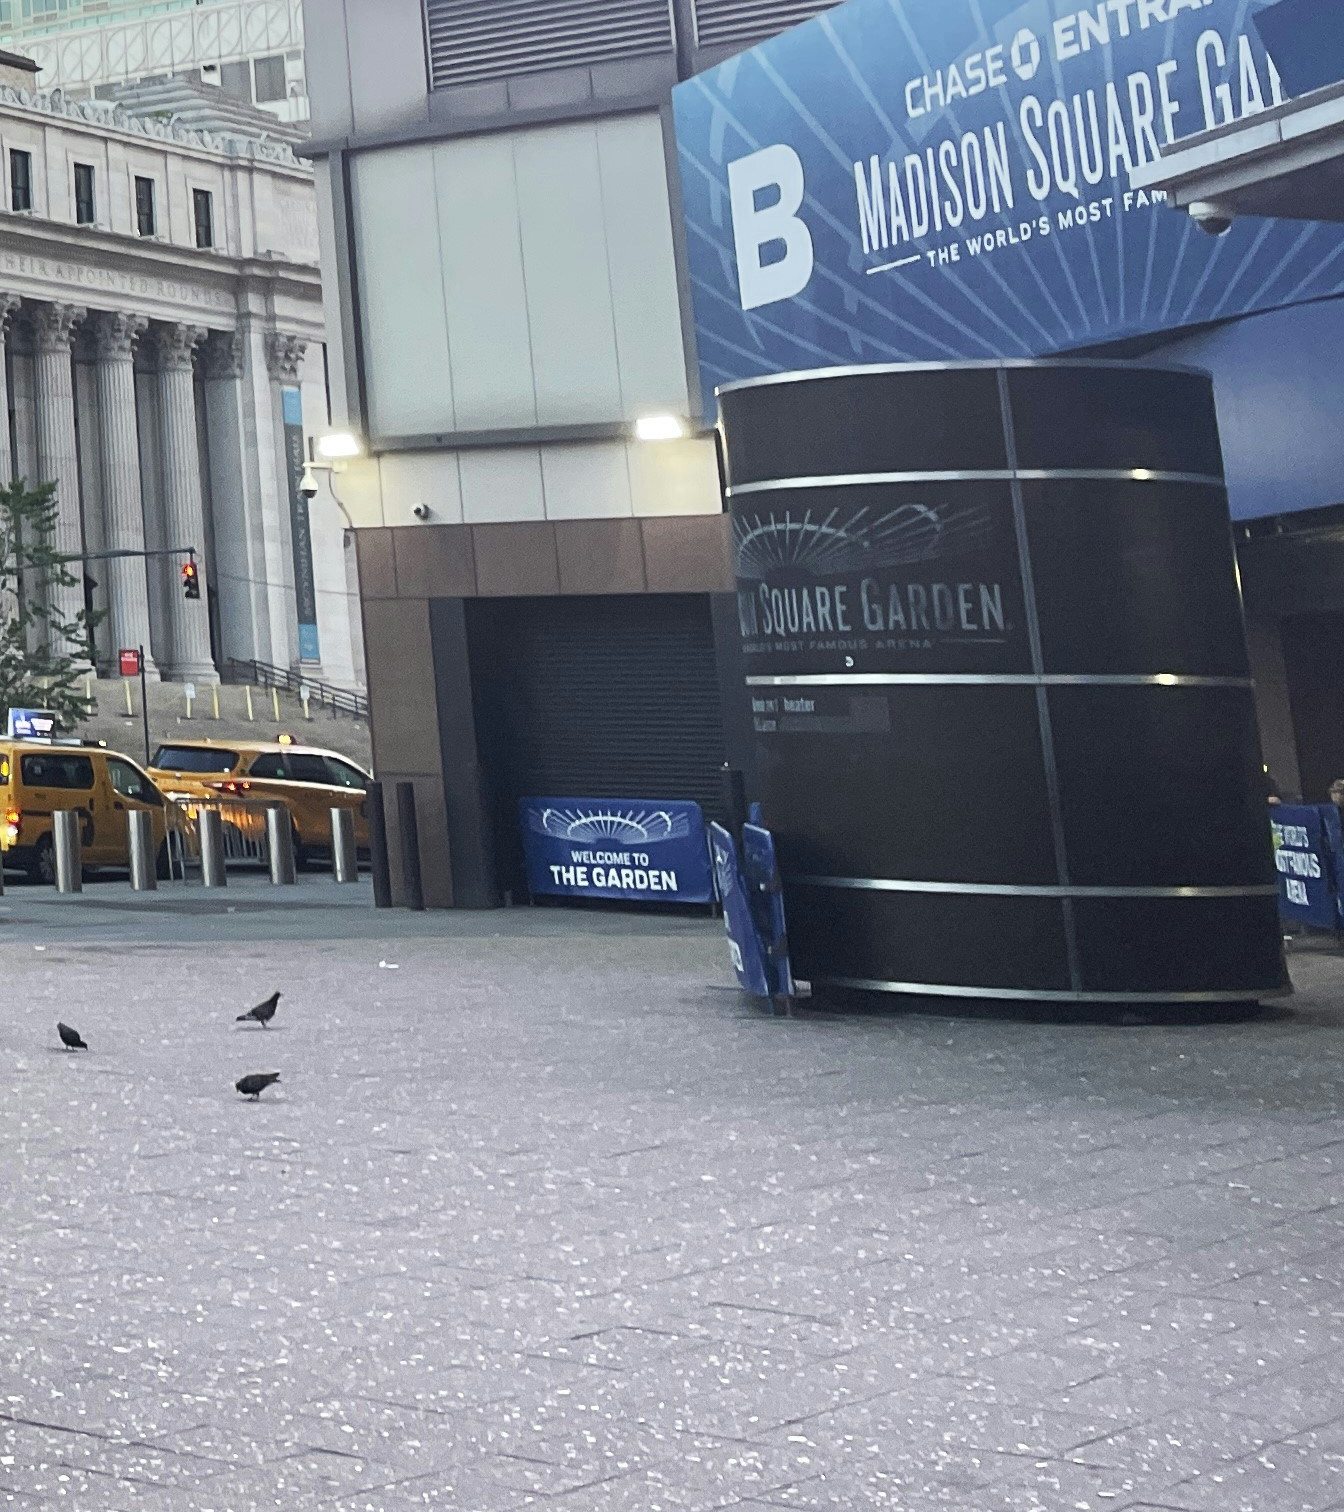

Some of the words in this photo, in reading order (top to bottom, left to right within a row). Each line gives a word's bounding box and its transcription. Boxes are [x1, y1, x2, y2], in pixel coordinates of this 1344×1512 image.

[904, 43, 1009, 120] CHASE
[726, 142, 815, 311] B
[853, 121, 1015, 256] MADISON
[926, 242, 961, 268] THE
[965, 218, 1051, 256] WORLD'S
[1058, 196, 1114, 232] MOST
[1123, 189, 1168, 212] FAM
[759, 583, 852, 637] SQUARE
[550, 866, 589, 887] THE
[592, 868, 678, 891] GARDEN
[571, 850, 630, 866] WELCOME
[633, 853, 649, 866] TO
